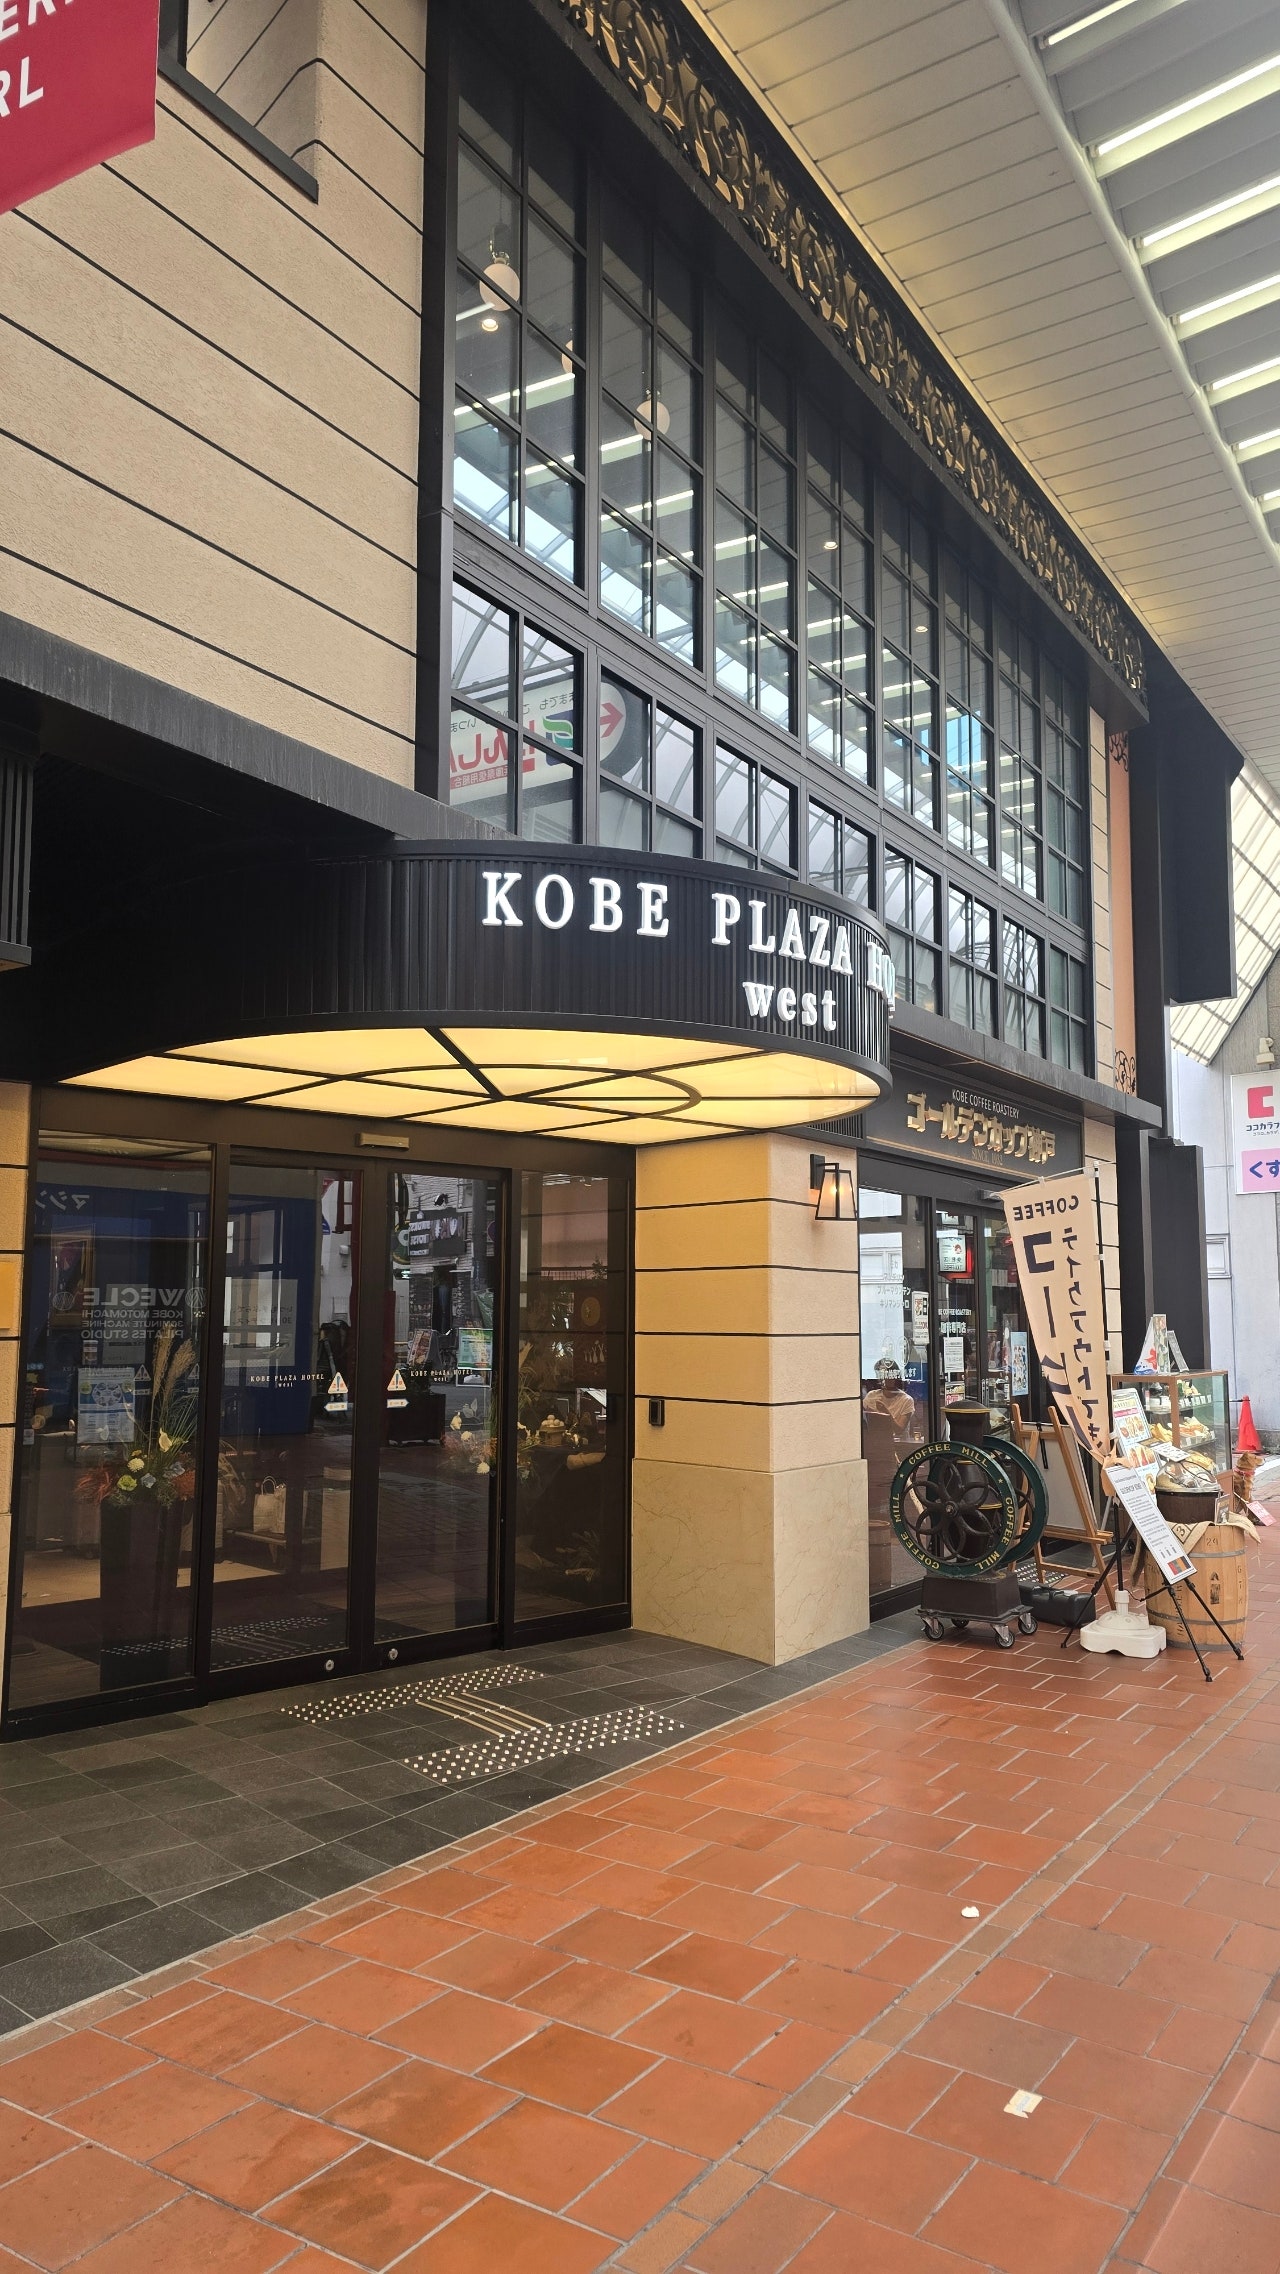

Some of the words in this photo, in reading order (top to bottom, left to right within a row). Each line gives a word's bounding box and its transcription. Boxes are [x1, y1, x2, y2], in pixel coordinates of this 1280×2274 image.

[482, 870, 670, 938] KOBE
[711, 892, 854, 976] PLAZA
[742, 981, 837, 1032] west
[951, 1088, 969, 1105] KOBE
[969, 1093, 992, 1112] COFFEE
[992, 1101, 1020, 1120] ROASTERY
[250, 1375, 270, 1383] KOBE
[274, 1374, 297, 1382] PLAZA
[301, 1373, 325, 1381] HOTEL
[908, 1443, 951, 1465] COFFEE
[961, 1446, 989, 1468] MILL
[892, 1493, 902, 1523] MILL
[1001, 1496, 1013, 1546] COFFEE
[1176, 1526, 1186, 1538] 3
[900, 1531, 940, 1570] COFFEE
[974, 1551, 1001, 1570] MILL
